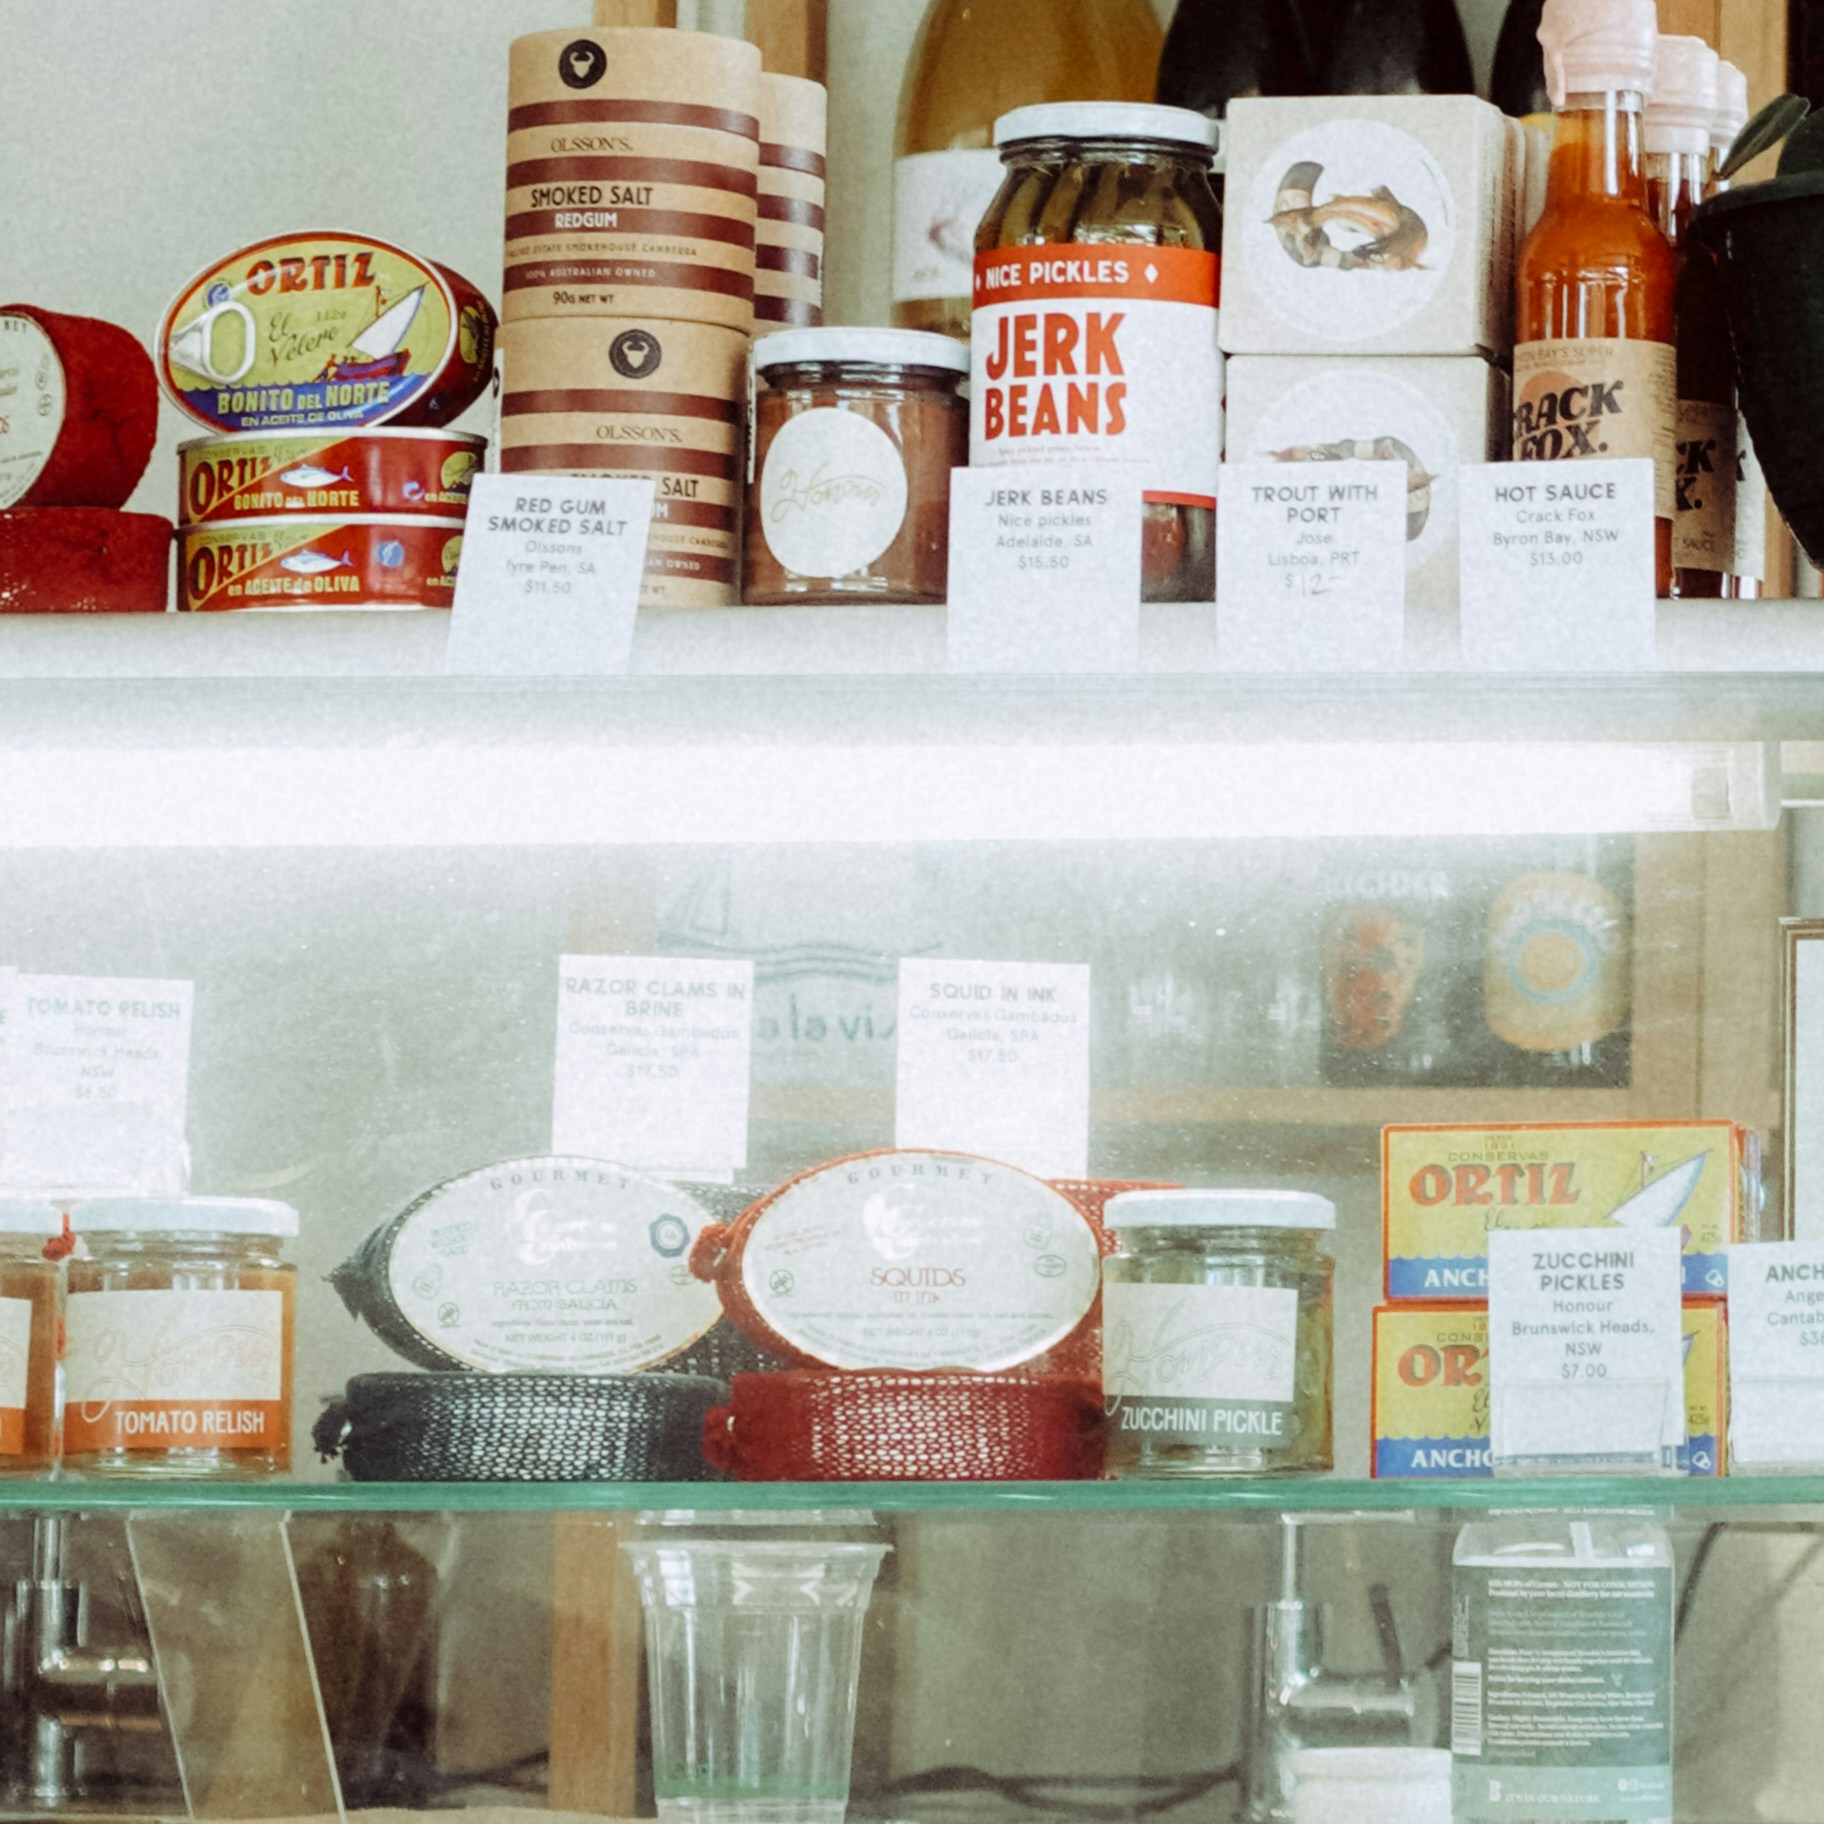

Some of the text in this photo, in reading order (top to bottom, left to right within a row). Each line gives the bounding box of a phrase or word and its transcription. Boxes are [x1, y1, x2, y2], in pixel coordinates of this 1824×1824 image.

[531, 185, 653, 207] SMOKED SALT
[555, 212, 618, 228] REDGUM
[641, 244, 698, 256] CANBERRA
[246, 251, 376, 296] ORTIZ
[549, 267, 656, 278] AUSTRALIAN OWNED
[985, 260, 1130, 290] NICE PICKLES
[578, 294, 614, 304] NET WT
[985, 312, 1126, 381] JERK
[217, 382, 390, 415] BONITO DEL NORTE
[985, 382, 1127, 441] BEANS
[662, 477, 699, 498] SALT
[1252, 485, 1378, 502] TROUT WITH
[1495, 483, 1616, 502] HOT SAUCE
[234, 490, 360, 511] BONITO NORTE
[515, 497, 606, 515] RED GUM
[985, 489, 1108, 506] JERK BEANS
[998, 514, 1093, 529] Nice pickles
[1287, 506, 1342, 523] PORT
[1516, 509, 1596, 524] Crack Fox
[487, 517, 628, 537] SMOKED SALT
[525, 540, 582, 554] Olssons
[1074, 535, 1093, 548] SA
[1296, 532, 1333, 545] Jose
[1493, 528, 1620, 550] Byron Bay, NSW
[1018, 555, 1070, 570] $15.50
[1269, 551, 1360, 567] Lisboa, PRT
[1530, 551, 1584, 567] $13.00
[577, 562, 596, 574] SA
[244, 576, 360, 594] ACEITE OLIVA
[525, 581, 572, 595] $11.50
[565, 978, 746, 1000] RAZOR CLAMS IN
[930, 982, 1057, 1003] SQUID IN INK
[26, 998, 181, 1019] TOMATO RELISH
[625, 1001, 683, 1018] BRINE
[1010, 1029, 1040, 1043] SPA
[80, 1065, 115, 1079] NSW
[1448, 1151, 1550, 1163] CONSERVAS
[490, 1169, 631, 1191] GOURMET
[848, 1164, 995, 1185] GOURMET
[1408, 1162, 1582, 1208] ORTIZ
[1532, 1252, 1634, 1270] ZUCCHINI
[869, 1266, 967, 1288] SQUIDS
[1540, 1273, 1625, 1291] PICKLES
[1553, 1299, 1614, 1312] Honour
[1512, 1320, 1656, 1336] Brunswick Heads,
[1565, 1342, 1602, 1356] NSW
[1561, 1363, 1608, 1379] $7.00
[115, 1410, 265, 1434] TOMATO RELISH
[1121, 1406, 1283, 1436] ZUCCHINI PICKLE
